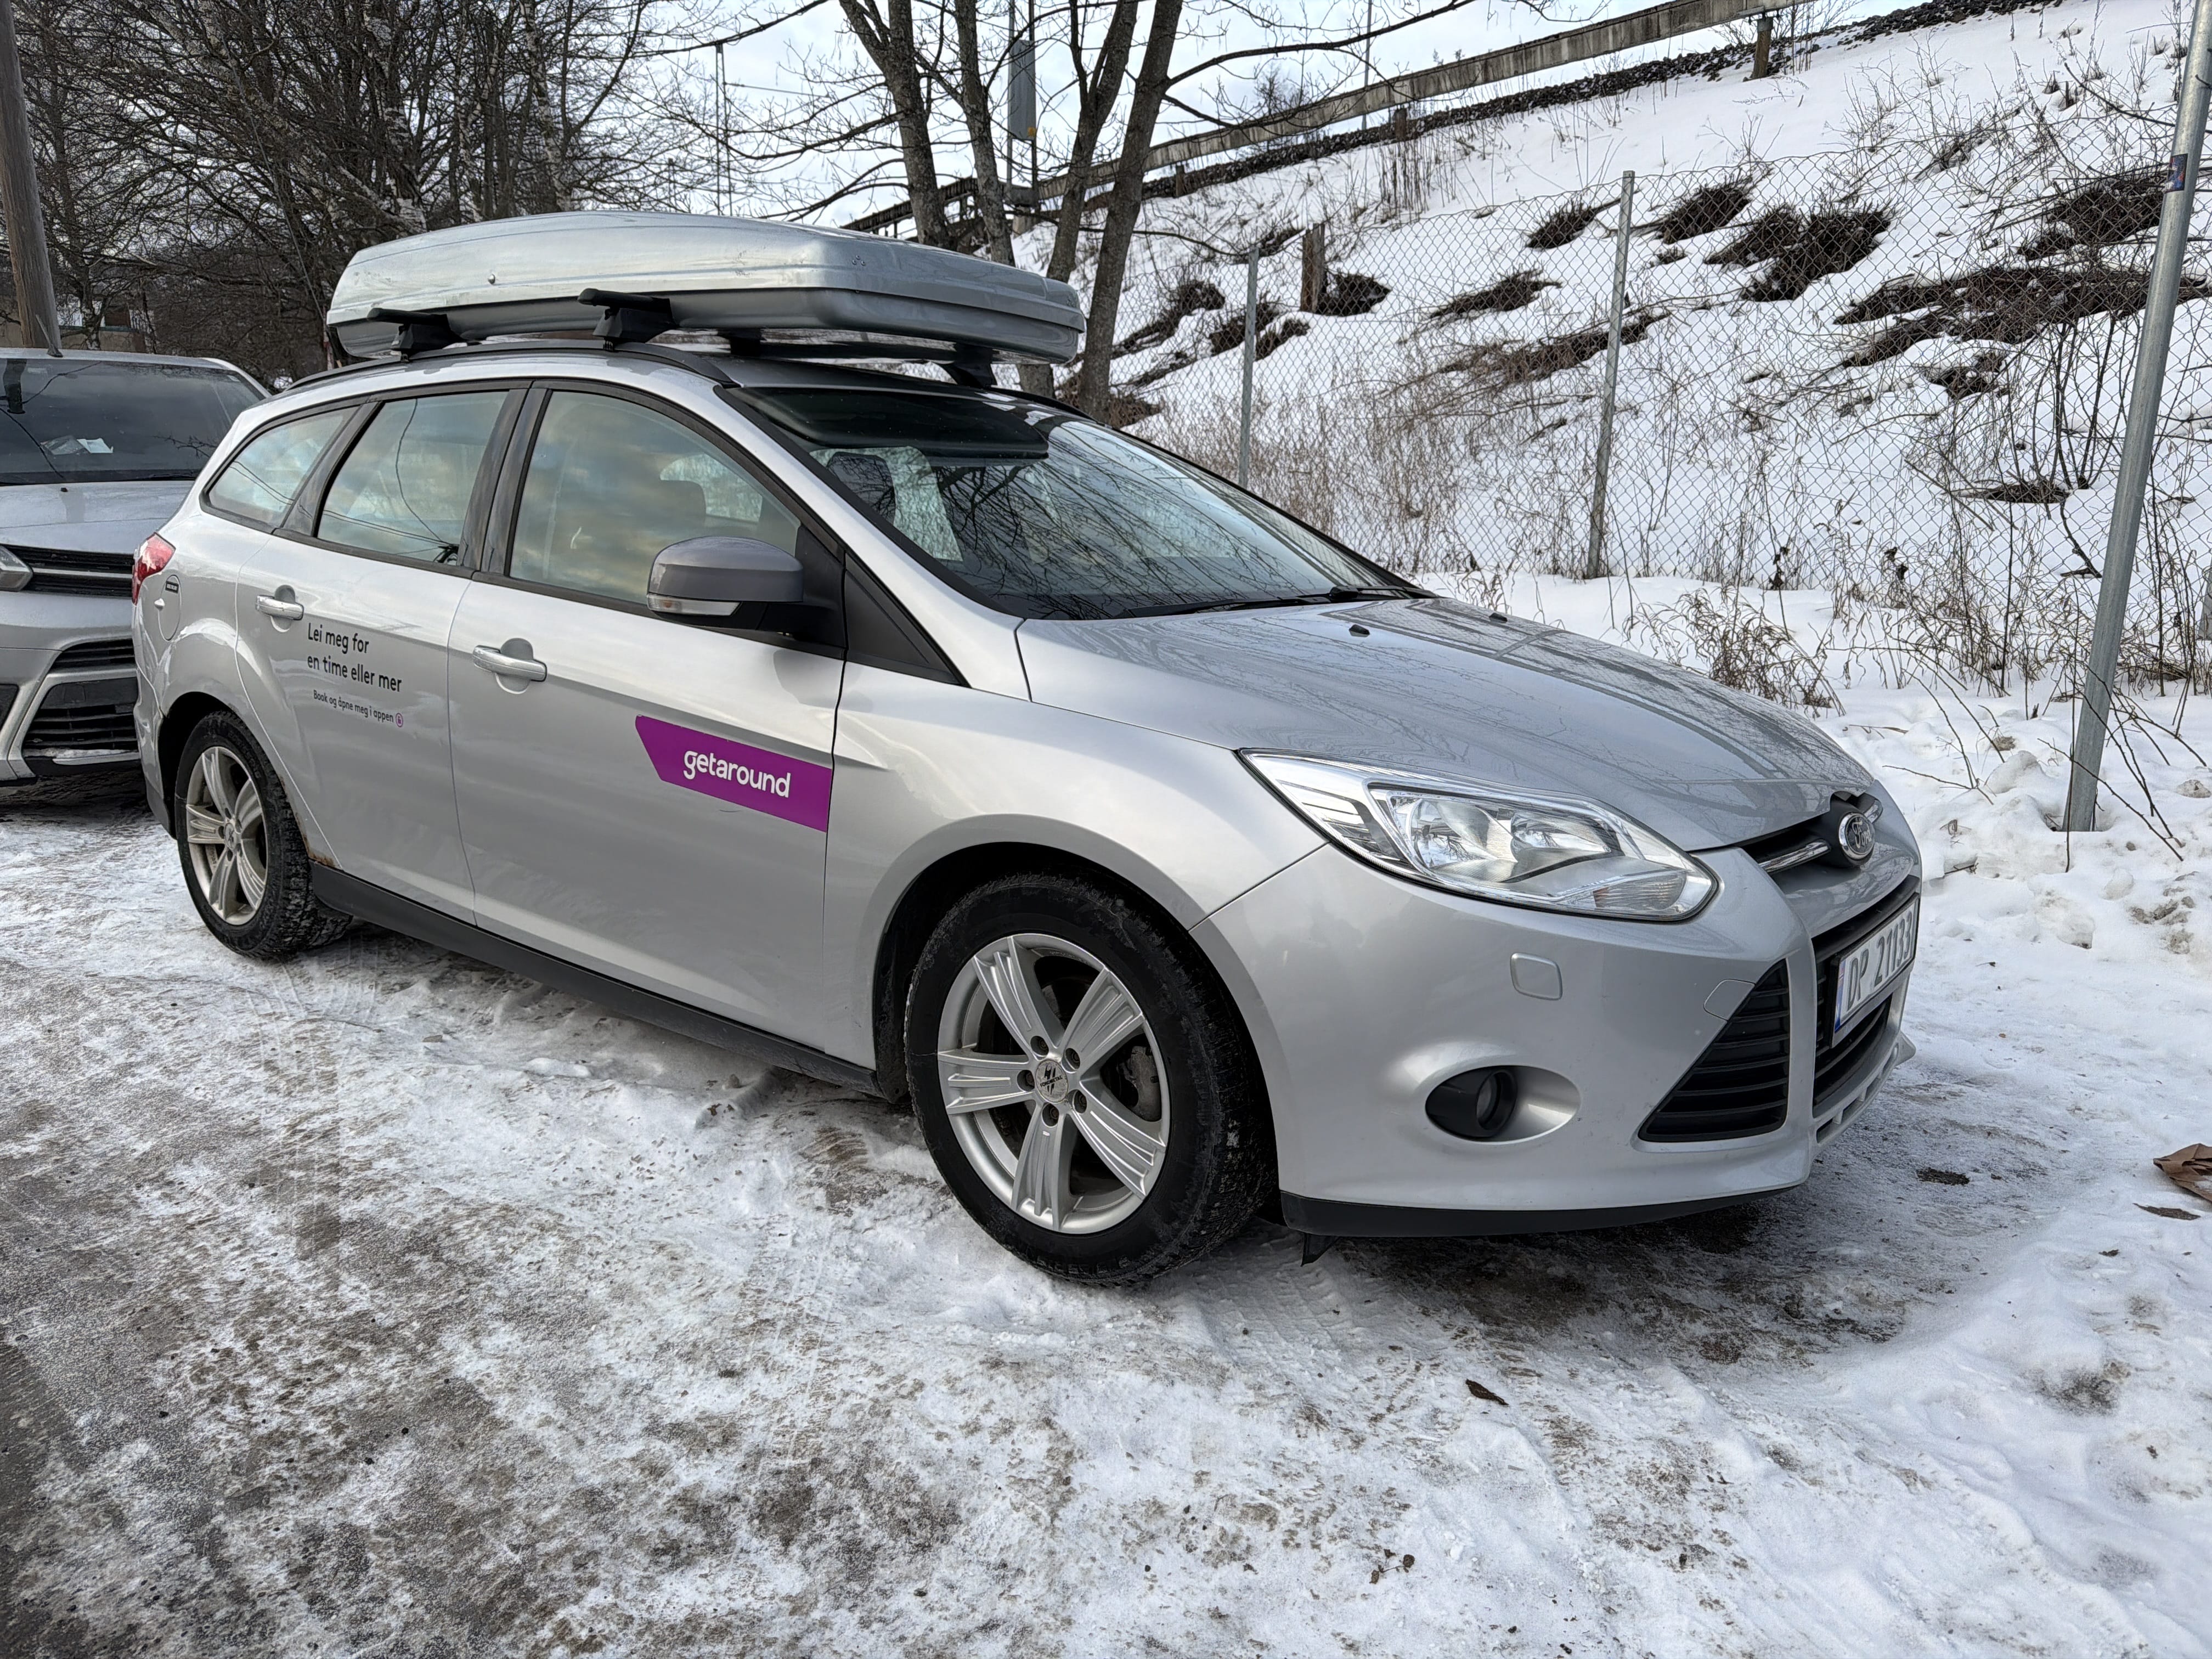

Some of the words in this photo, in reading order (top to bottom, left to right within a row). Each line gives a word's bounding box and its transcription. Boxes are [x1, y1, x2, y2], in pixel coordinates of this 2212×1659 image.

[308, 623, 323, 642] Lei
[325, 632, 349, 654] meg
[352, 633, 369, 653] for
[308, 656, 319, 670] en
[323, 656, 348, 678] time
[351, 664, 375, 685] eller
[379, 674, 402, 692] mer
[313, 690, 328, 703] Book
[329, 696, 336, 708] og
[338, 697, 353, 711] åpne
[355, 703, 368, 718] meg
[374, 710, 394, 723] appen
[683, 750, 791, 798] getaround
[1852, 817, 1872, 849] Ford
[1847, 948, 1869, 1011] DP
[1874, 910, 1912, 987] 21133
